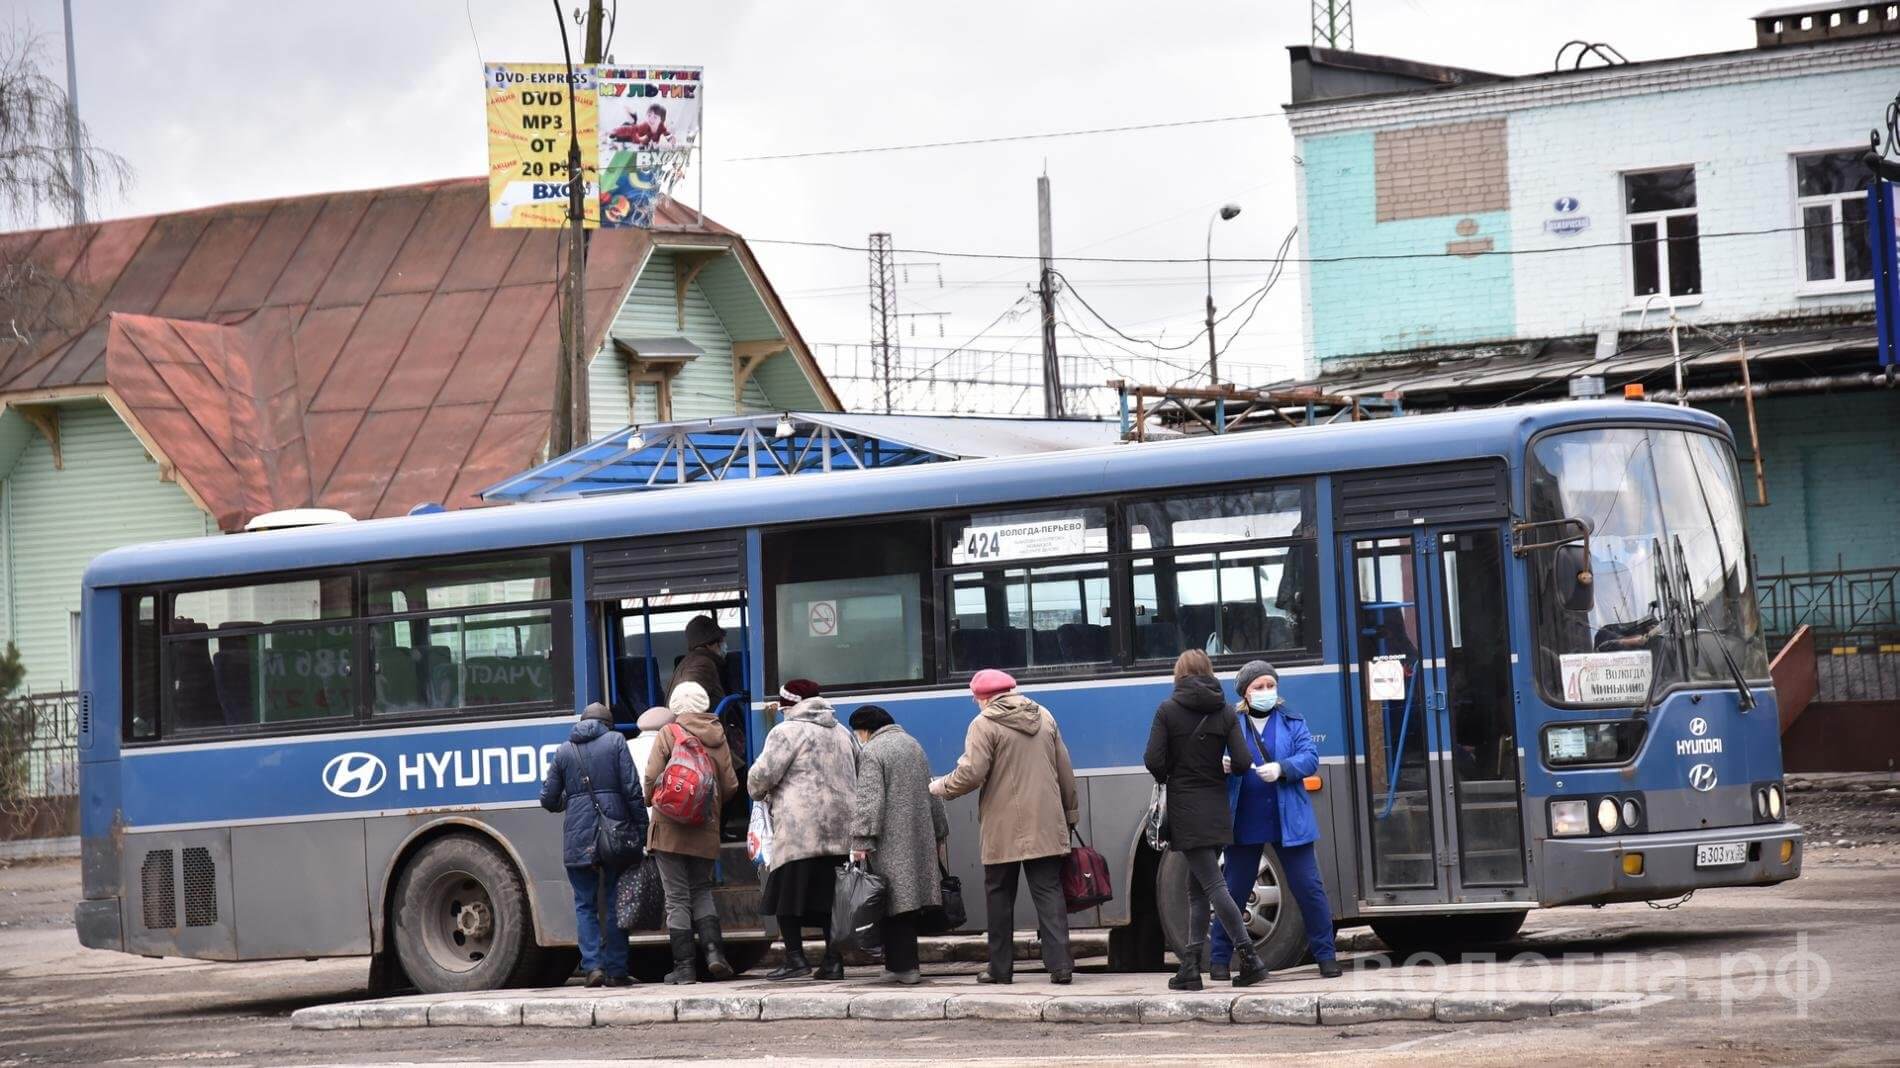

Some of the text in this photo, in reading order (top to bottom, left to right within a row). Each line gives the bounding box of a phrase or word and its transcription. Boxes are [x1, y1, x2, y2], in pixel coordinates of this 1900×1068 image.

[600, 82, 696, 98] МУЛЬТИК
[522, 91, 563, 106] DVD
[522, 115, 563, 129] MP3
[531, 138, 556, 153] ОТ
[522, 162, 543, 177] 20
[533, 184, 571, 200] ВХО
[1561, 198, 1570, 211] 2
[968, 532, 1000, 559] 424
[1000, 522, 1082, 537] ВОЛОГДА-ПЕРЬЕВО
[1676, 738, 1722, 755] HYUNDAI
[399, 744, 562, 791] HYUNDA
